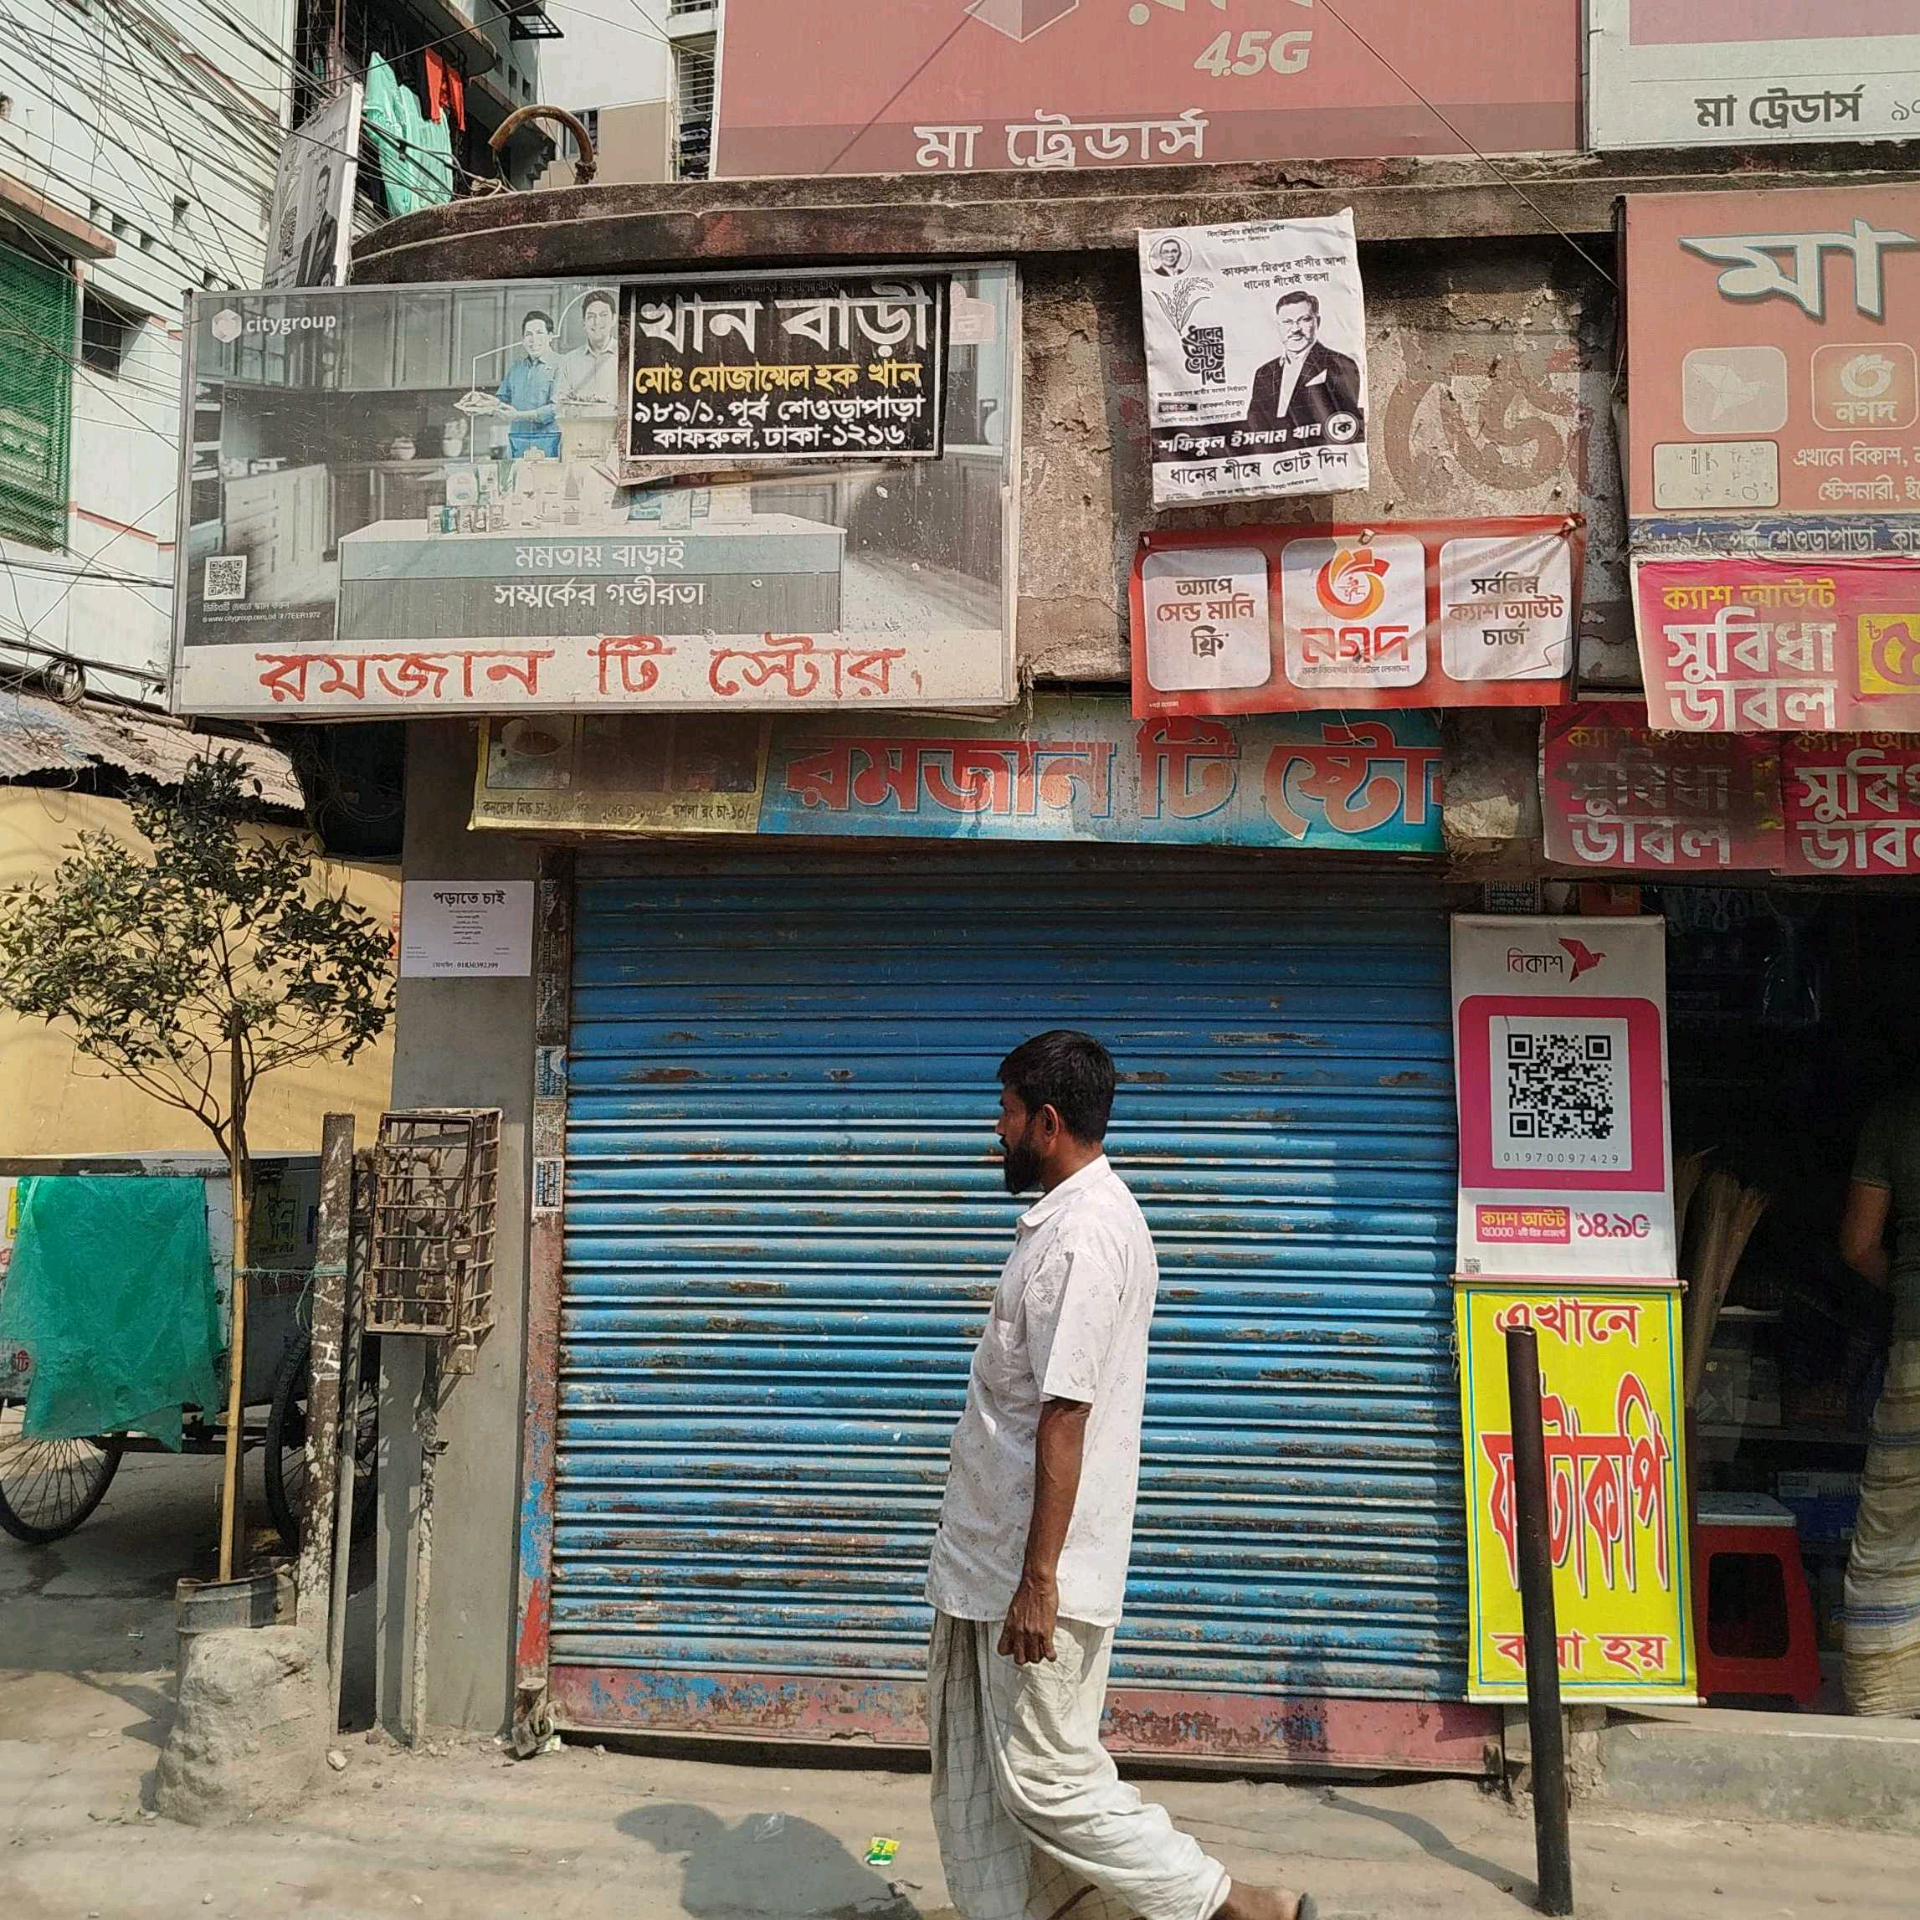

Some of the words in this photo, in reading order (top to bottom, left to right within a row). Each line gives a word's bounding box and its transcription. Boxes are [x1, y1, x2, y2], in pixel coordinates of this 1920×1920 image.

[1194, 30, 1313, 77] 4.5G
[1694, 94, 1738, 127] মা
[1749, 83, 1867, 129] ট্রেডার্স
[913, 125, 983, 168] মা
[1004, 108, 1210, 168] ট্রেডার্স
[1221, 261, 1292, 277] কাফরুল-মিরপুর
[1294, 255, 1322, 268] বাসীর
[1323, 255, 1347, 267] আশা
[1243, 278, 1271, 290] ধানের
[1273, 273, 1302, 286] শীষেই
[1304, 272, 1330, 283] ভরসা
[1677, 217, 1917, 317] মা
[246, 313, 337, 340] citygroup
[639, 292, 764, 354] খান
[775, 279, 935, 357] বাড়ী
[635, 362, 683, 395] মোঃ
[689, 361, 812, 394] মোজাম্মেল
[814, 363, 861, 393] হক
[868, 358, 924, 390] খান
[634, 398, 724, 426] ৯৮৯/১,
[728, 393, 770, 427] পূর্ব
[777, 394, 927, 424] শেওড়াপাড়া
[1831, 400, 1898, 424] নগদ
[652, 427, 760, 451] কাফরুল,
[762, 423, 906, 448] ঢাকা-১২১৬
[1158, 432, 1226, 457] শফিকুল
[1230, 427, 1288, 446] ইসলাম
[1291, 423, 1322, 438] খান
[1793, 448, 1845, 467] এখানে
[1849, 440, 1908, 468] বিকাশ,
[1169, 464, 1218, 485] ধানের
[1222, 458, 1261, 480] শীষে
[1272, 452, 1312, 475] ভোট
[1316, 447, 1349, 469] দিন
[514, 543, 603, 570] মমতায়
[611, 538, 686, 573] বাড়াই
[494, 576, 596, 608] সম্পর্কের
[607, 576, 706, 608] গভীরতা
[1175, 577, 1233, 596] অ্যাপে
[1471, 570, 1541, 595] সর্বনিম্ন
[1662, 585, 1734, 610] ক্যাশ
[1740, 577, 1836, 608] আউটে
[1156, 600, 1202, 622] সেন্ড
[1207, 594, 1255, 620] মানি
[1448, 601, 1500, 622] ক্যাশ
[1503, 593, 1564, 620] আউট
[1301, 624, 1409, 664] নগদ
[1663, 606, 1837, 683] সুবিধা
[255, 650, 556, 702] রমজান
[587, 632, 678, 694] টি
[709, 631, 906, 699] স্টোর
[1665, 678, 1839, 730] ডাবল
[784, 738, 1116, 818] রমজান
[1136, 714, 1241, 820] টি
[1262, 721, 1442, 842] ষ্টো
[1567, 813, 1733, 864] ডাবল
[433, 891, 479, 908] পড়াতে
[481, 889, 506, 905] চাই
[1506, 947, 1564, 974] বিকাশ
[1503, 1151, 1619, 1165] 01970097429
[1481, 1211, 1518, 1226] ক্যাশ
[1521, 1209, 1566, 1227] আউট
[1495, 1297, 1644, 1347] এখানে
[1595, 1632, 1674, 1676] হয়
